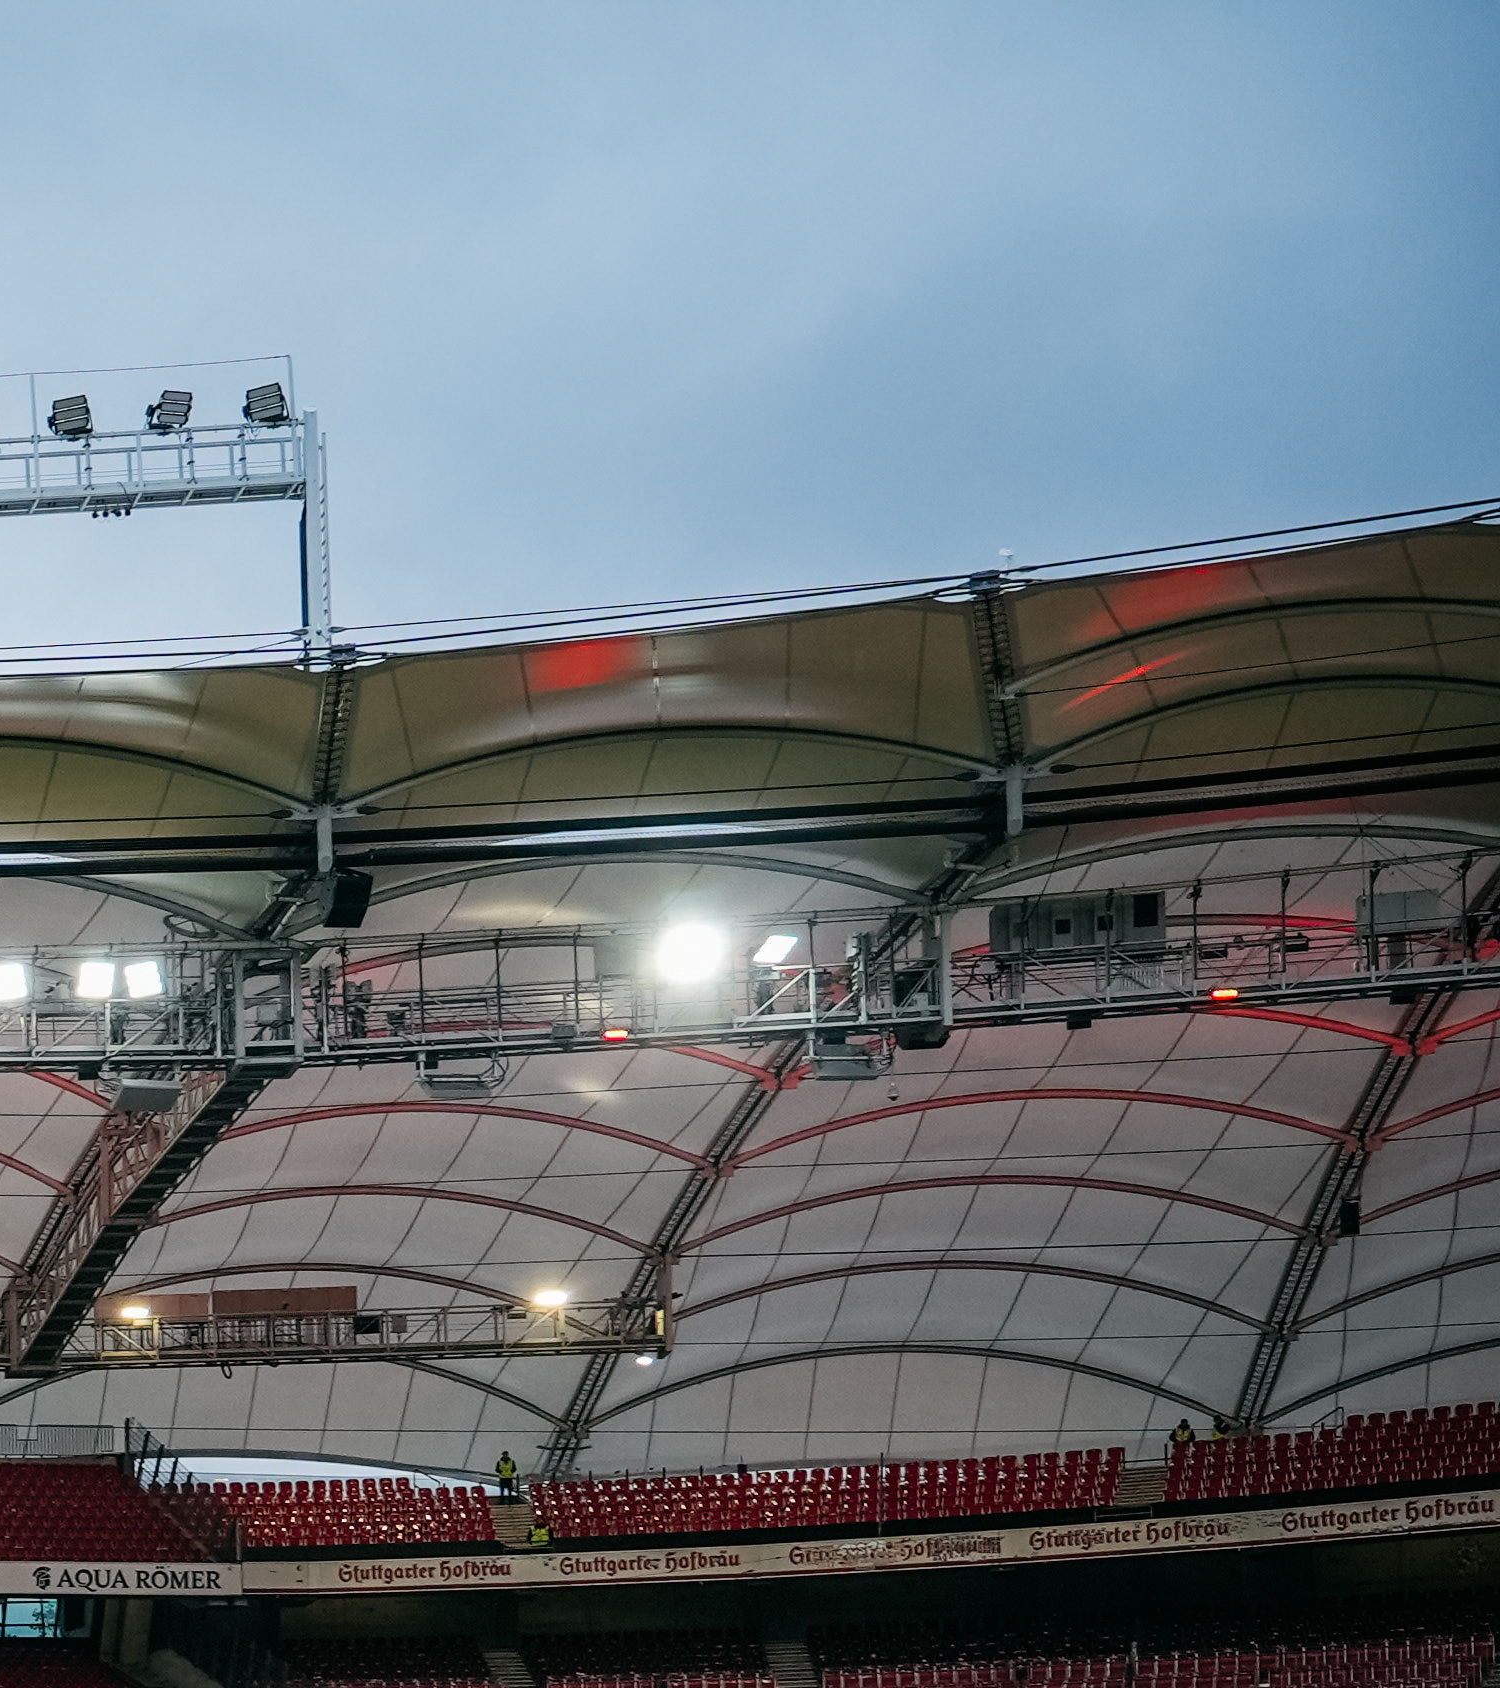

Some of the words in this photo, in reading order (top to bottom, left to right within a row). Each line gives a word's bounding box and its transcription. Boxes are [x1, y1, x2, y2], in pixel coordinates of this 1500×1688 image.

[1281, 1505, 1401, 1533] Stuttgarter
[1404, 1495, 1495, 1523] Hofbräu
[57, 1567, 129, 1592] AQUA
[135, 1565, 221, 1589] RÖMER
[338, 1561, 436, 1584] Stuttgarter
[439, 1559, 512, 1582] Hofbräu
